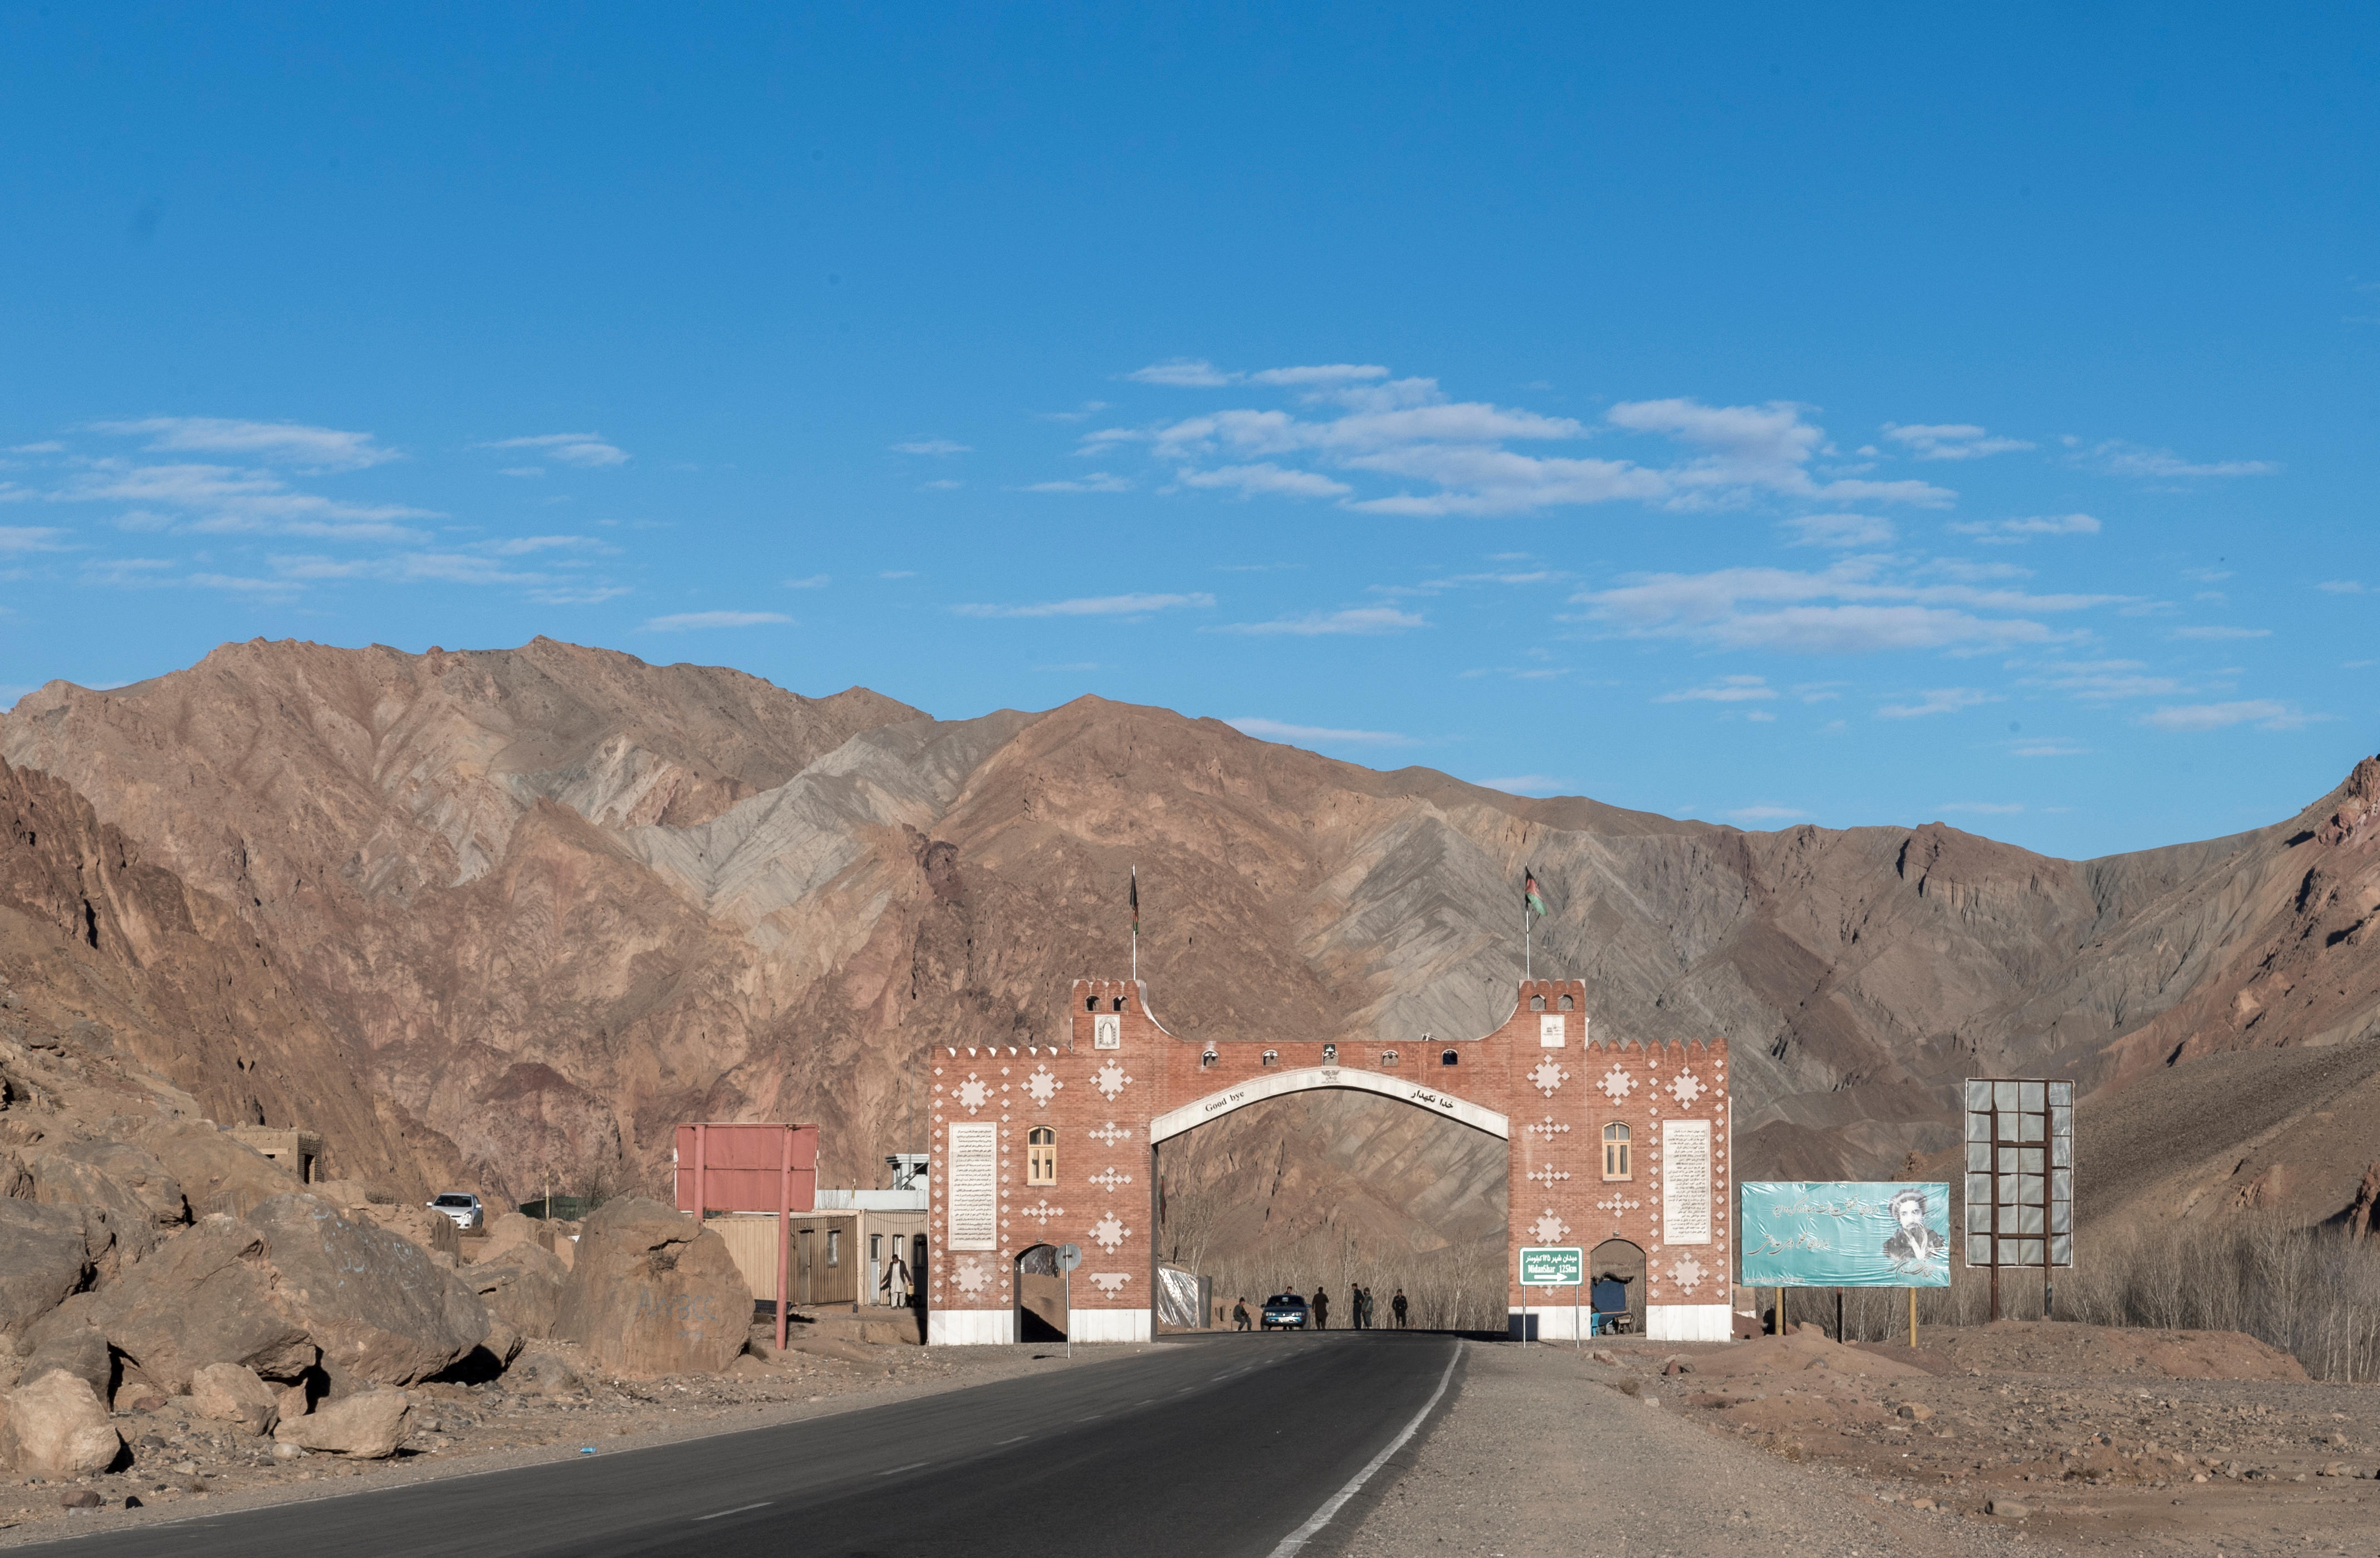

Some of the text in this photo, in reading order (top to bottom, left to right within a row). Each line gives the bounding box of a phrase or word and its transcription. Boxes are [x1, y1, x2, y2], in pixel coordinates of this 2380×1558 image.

[1206, 1091, 1245, 1112] Good bye
[1439, 1098, 1453, 1108] خدا
[1551, 1254, 1562, 1263] شهر
[1563, 1254, 1578, 1263] میدان
